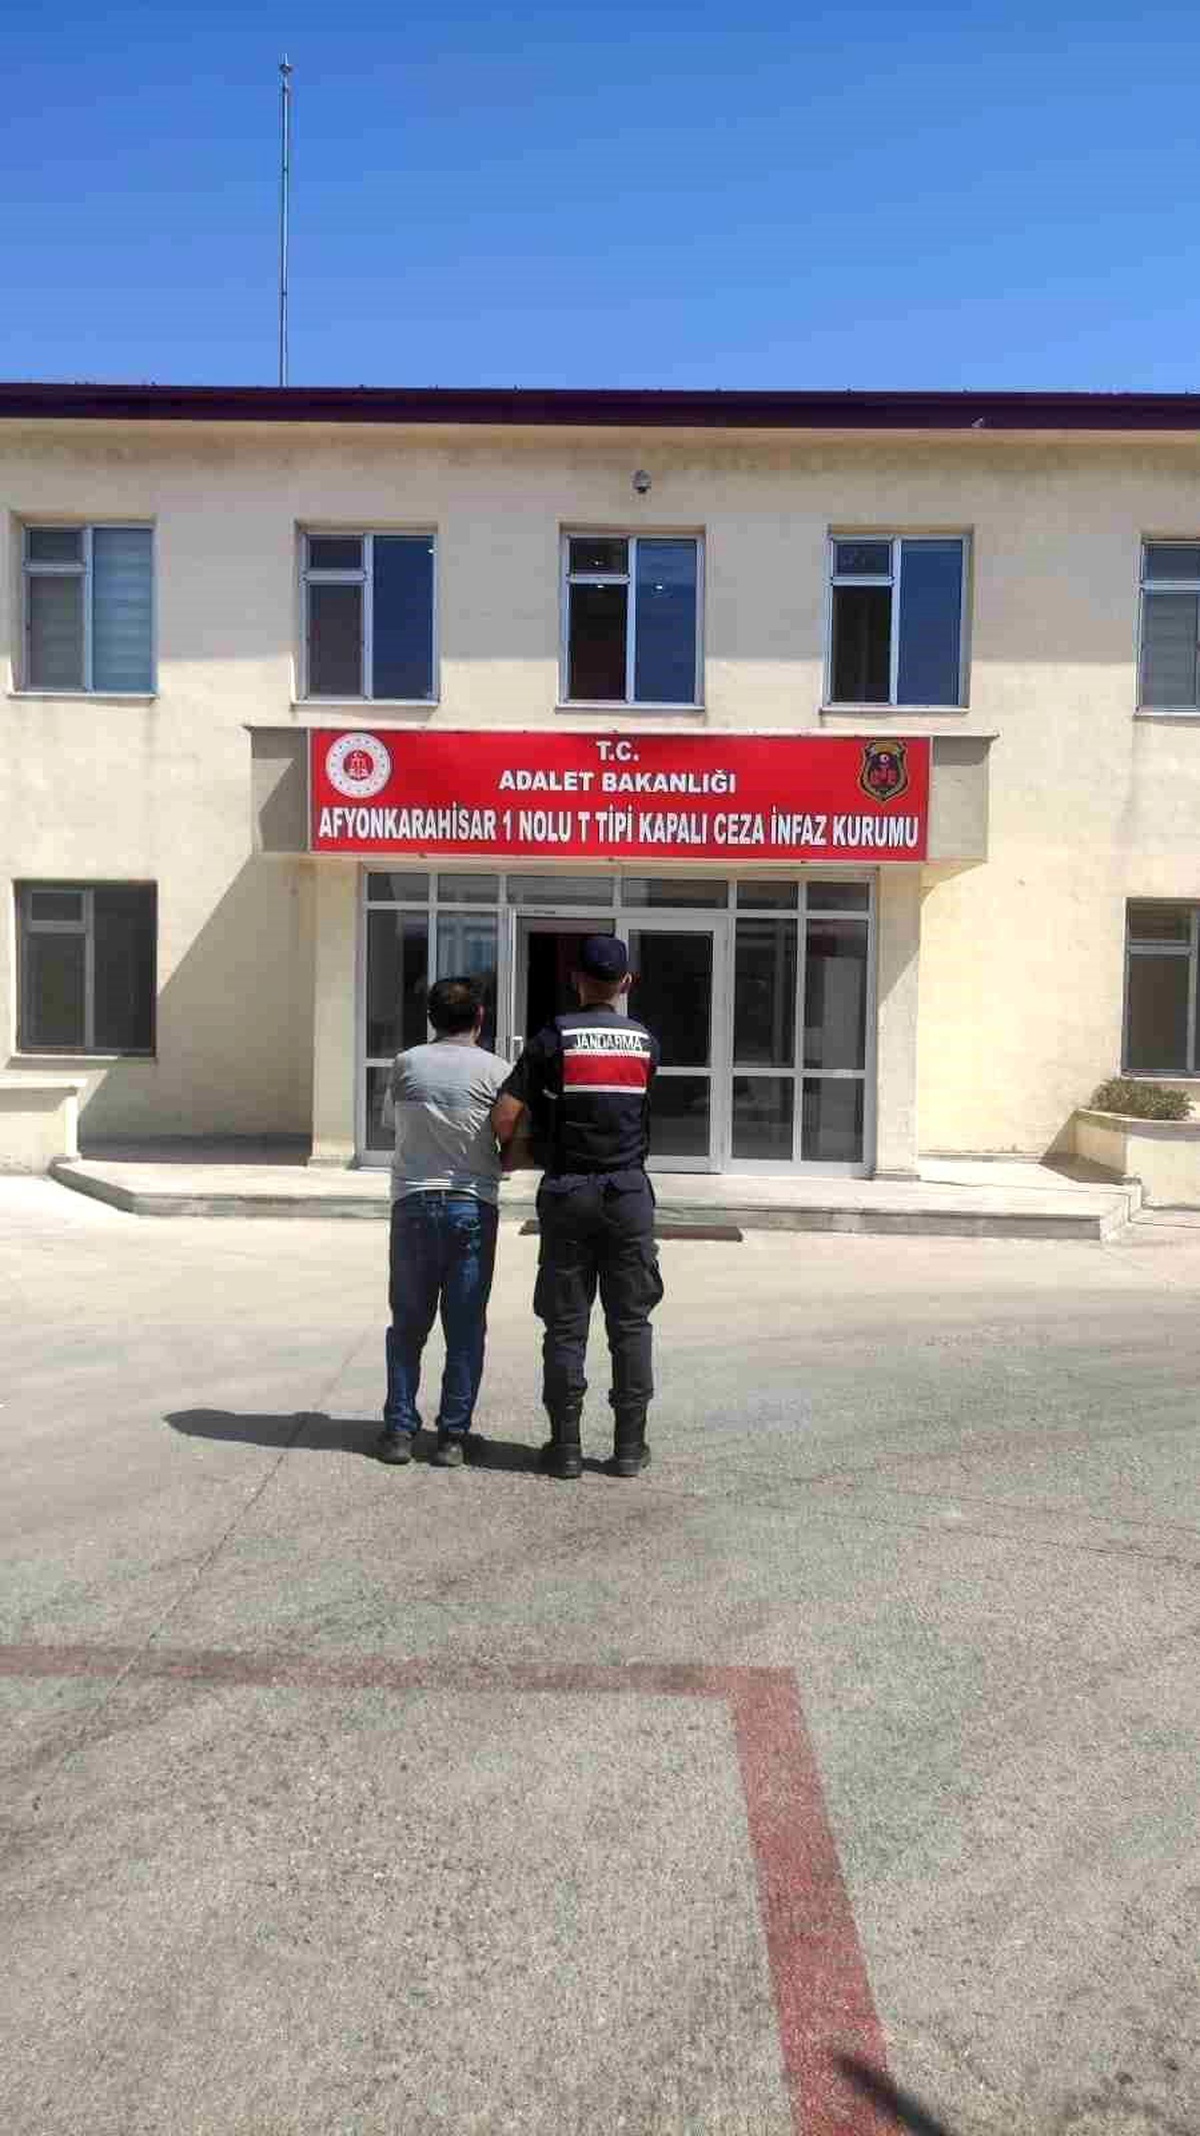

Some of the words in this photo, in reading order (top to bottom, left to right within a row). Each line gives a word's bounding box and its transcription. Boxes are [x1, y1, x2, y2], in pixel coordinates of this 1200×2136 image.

[596, 740, 639, 762] T.C.
[498, 770, 595, 791] ADALET
[602, 768, 736, 794] BAKANLIĞI
[318, 801, 497, 841] AFYONKARAHİSAR
[502, 810, 512, 841] 1
[518, 810, 572, 843] NOLU
[577, 811, 591, 843] T
[594, 804, 633, 844] TİPİ
[638, 812, 708, 845] KAPALI
[713, 812, 765, 846] CEZA
[770, 805, 828, 847] İNFAZ
[832, 814, 919, 848] KURUMU
[575, 1034, 643, 1050] JANDARMA
